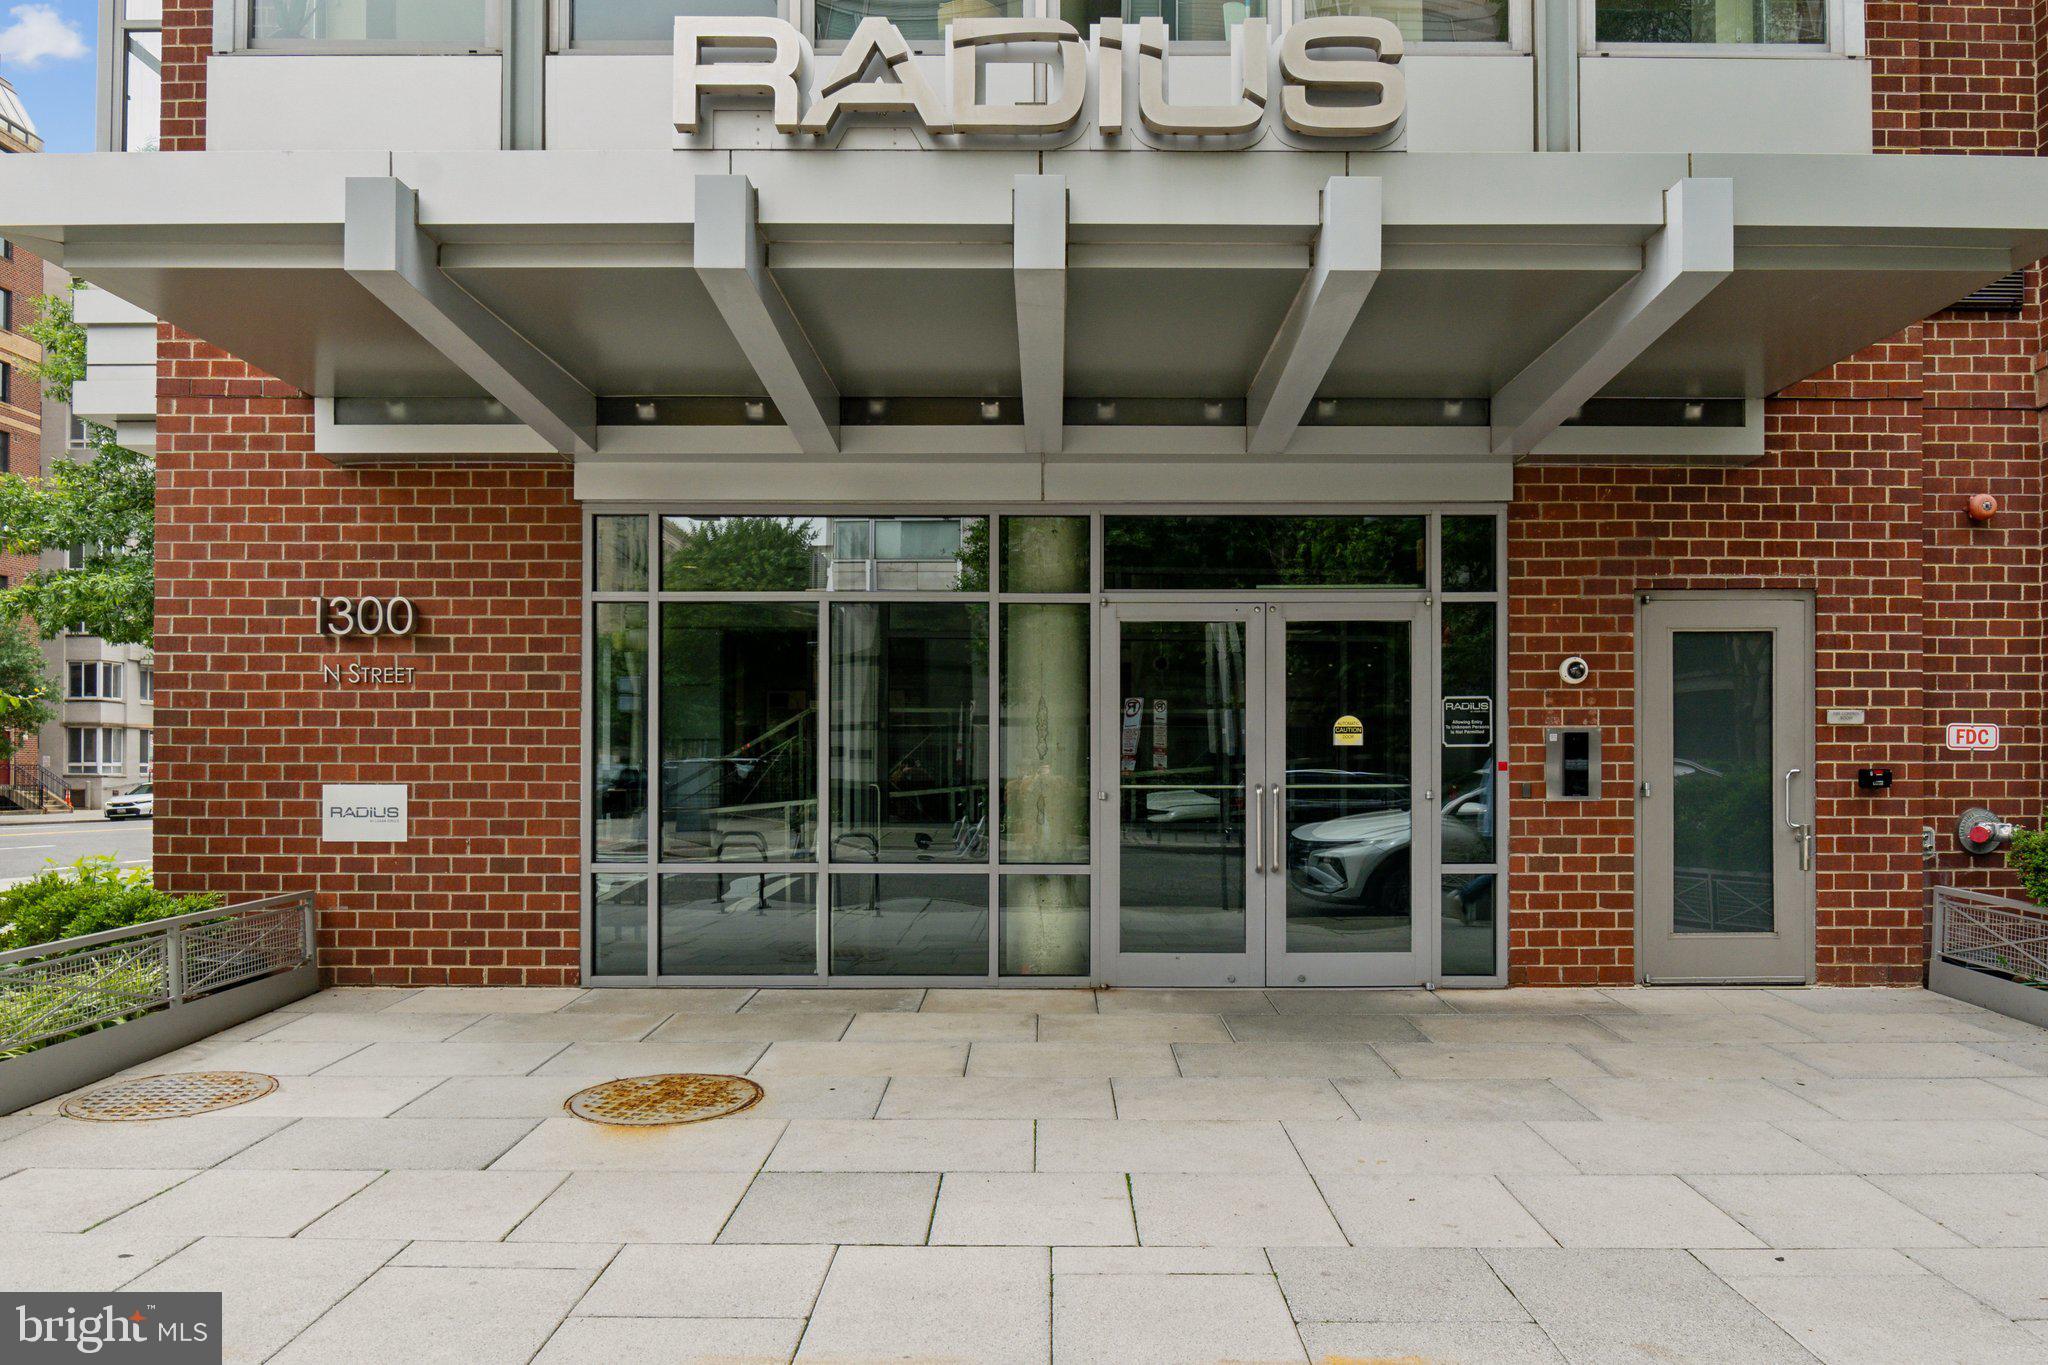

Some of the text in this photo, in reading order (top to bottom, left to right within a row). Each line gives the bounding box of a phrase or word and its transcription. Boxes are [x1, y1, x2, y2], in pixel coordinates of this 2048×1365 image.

[311, 596, 413, 635] 1300
[324, 664, 340, 683] N
[1956, 729, 1989, 745] FDC
